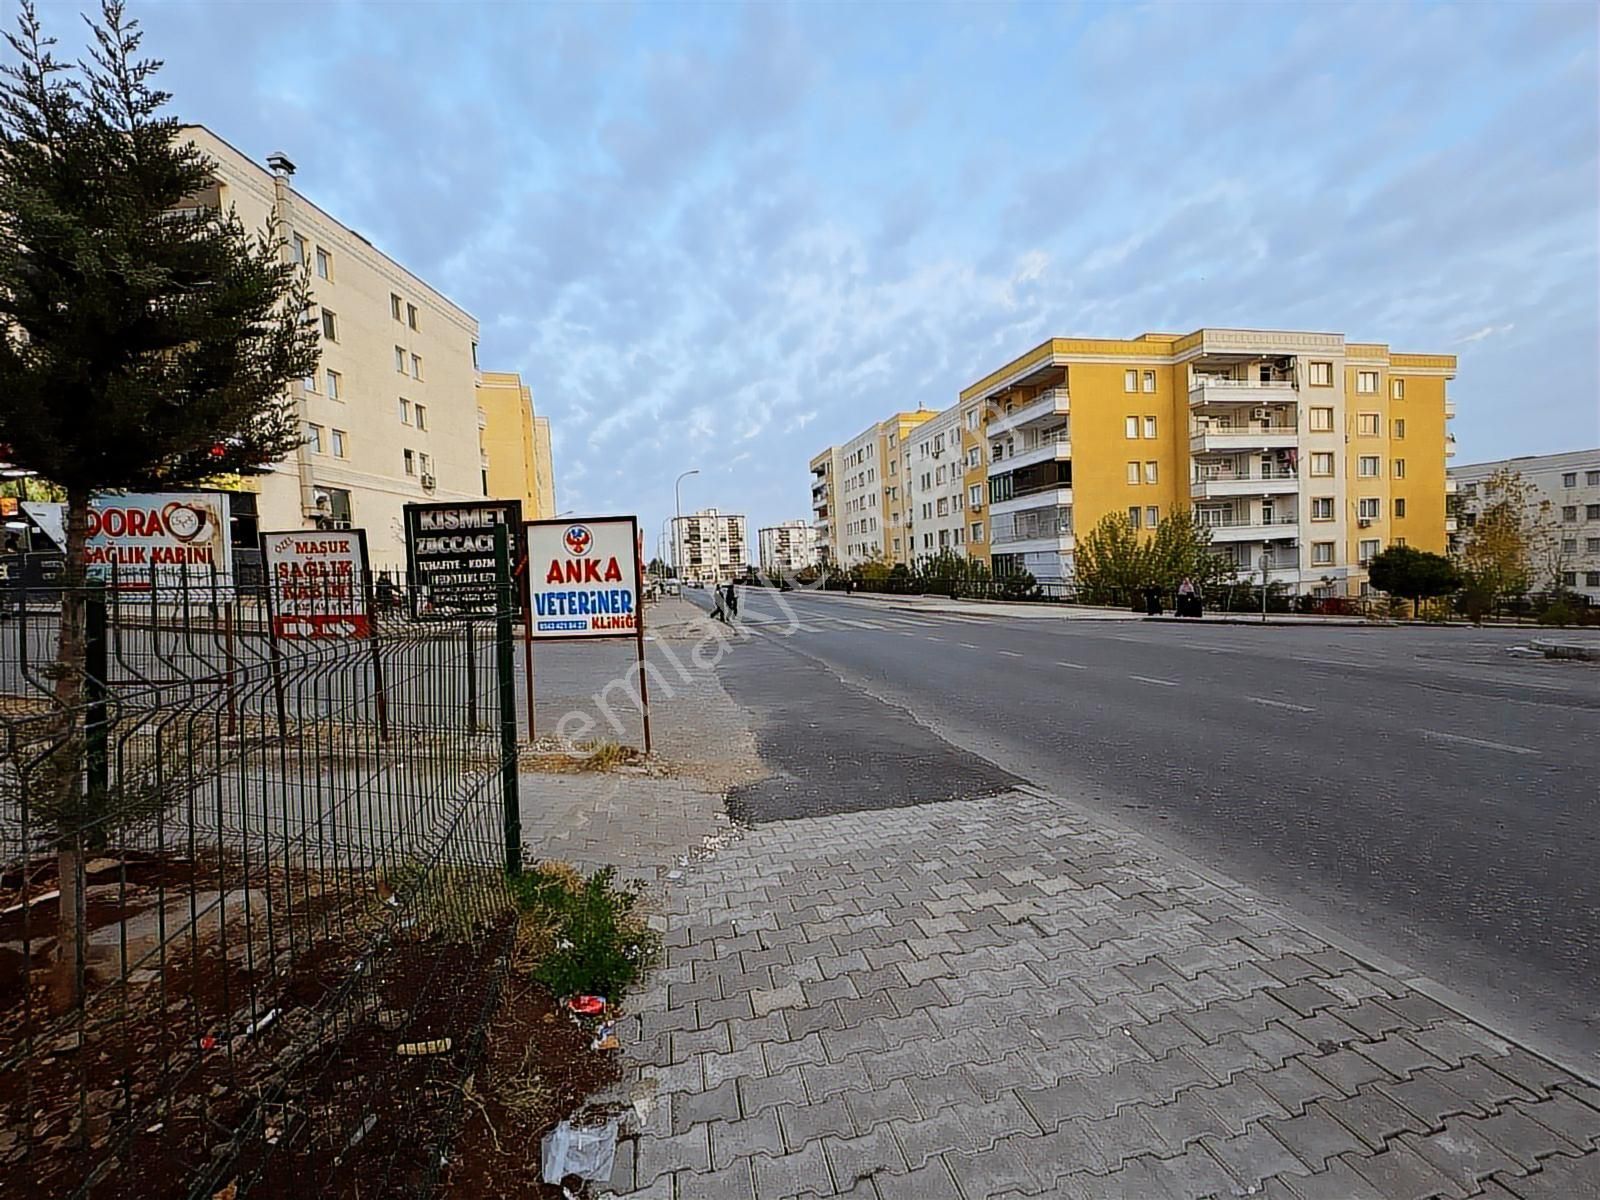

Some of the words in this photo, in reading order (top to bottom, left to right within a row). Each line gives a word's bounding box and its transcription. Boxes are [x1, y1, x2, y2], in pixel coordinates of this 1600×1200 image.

[420, 508, 507, 530] KISMET
[84, 541, 146, 564] SAĞLIK
[151, 542, 212, 564] KABİNİ
[295, 540, 351, 557] MAŞUK
[416, 534, 515, 554] ZÜCCACİE
[279, 556, 353, 578] SAĞLIK
[468, 558, 515, 569] KOZMK
[546, 557, 622, 584] ANKA
[535, 590, 633, 616] VETERİNER
